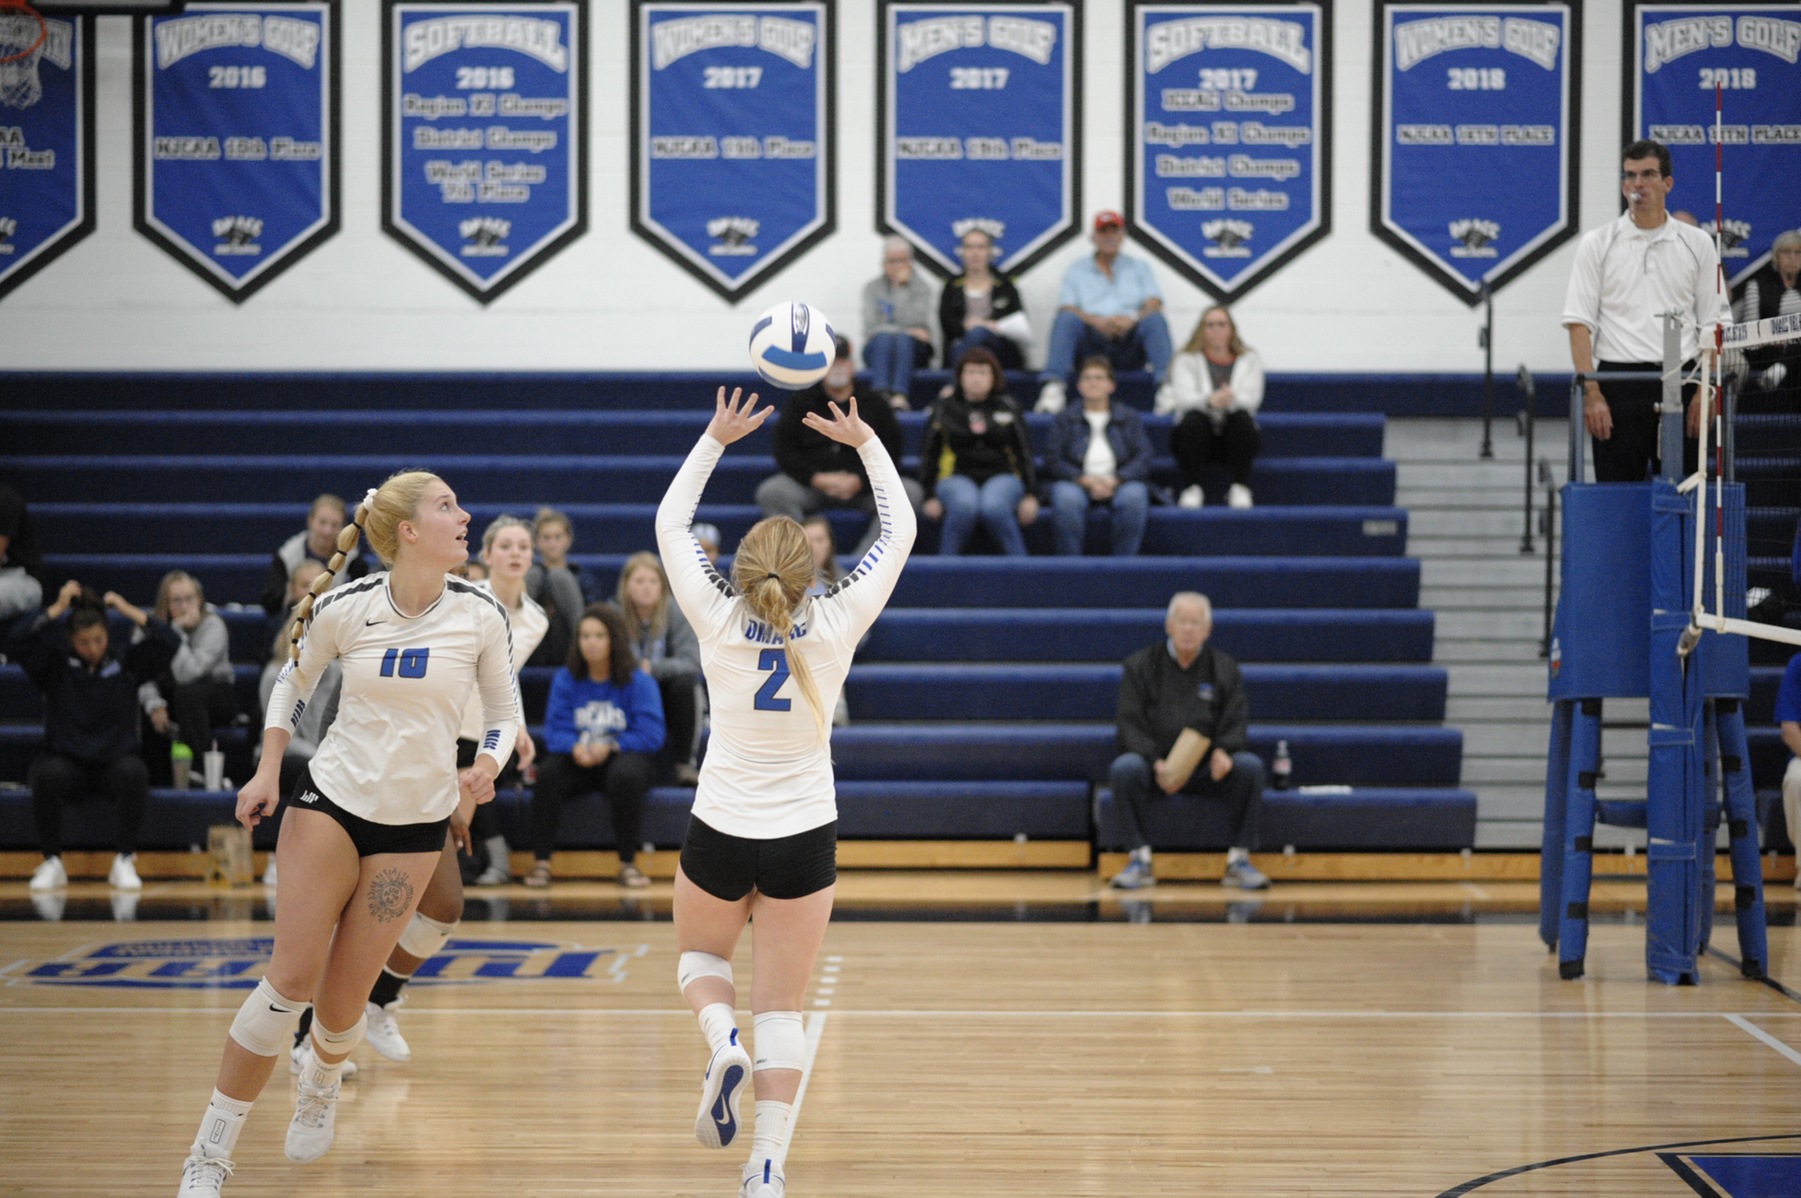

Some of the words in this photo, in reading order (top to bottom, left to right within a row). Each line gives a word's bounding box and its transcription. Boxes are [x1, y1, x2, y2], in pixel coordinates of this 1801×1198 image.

[154, 15, 261, 69] WOMEN'S
[264, 16, 320, 69] GOLF
[404, 16, 568, 73] SOFTBALL
[898, 16, 985, 73] MEN'S
[988, 16, 1057, 66] GOLF
[1146, 16, 1311, 74] SOFTBALL
[1396, 16, 1501, 72] WOMEN'S
[1502, 17, 1560, 71] GOLF
[1645, 15, 1732, 73] MEN'S
[1736, 15, 1801, 64] GOLF
[208, 66, 266, 88] 2016
[457, 67, 515, 90] 2016
[703, 67, 762, 89] 2017
[950, 68, 1010, 90] 2017
[1198, 69, 1258, 90] 2017
[1447, 68, 1506, 90] 2018
[1698, 68, 1757, 90] 2018
[403, 93, 467, 120] Region
[498, 93, 569, 120] Champs
[1224, 91, 1295, 114] Champs
[413, 126, 484, 149] District
[486, 127, 558, 153] Champs
[1146, 121, 1210, 148] Region
[1240, 121, 1311, 148] Champs
[1500, 125, 1555, 146] PLACE
[1649, 124, 1705, 145] NJCAA
[1751, 124, 1801, 145] PLACE
[154, 137, 220, 160] NJCAA
[270, 137, 320, 160] Place
[764, 136, 815, 159] Place
[1010, 137, 1062, 160] Place
[424, 160, 484, 182] World
[486, 160, 546, 183] Series
[1156, 154, 1227, 178] District
[1228, 154, 1300, 181] Champs
[476, 181, 530, 202] Place
[1166, 187, 1225, 210] World
[1227, 187, 1289, 210] Series
[379, 647, 430, 679] 10
[754, 648, 792, 712] 2
